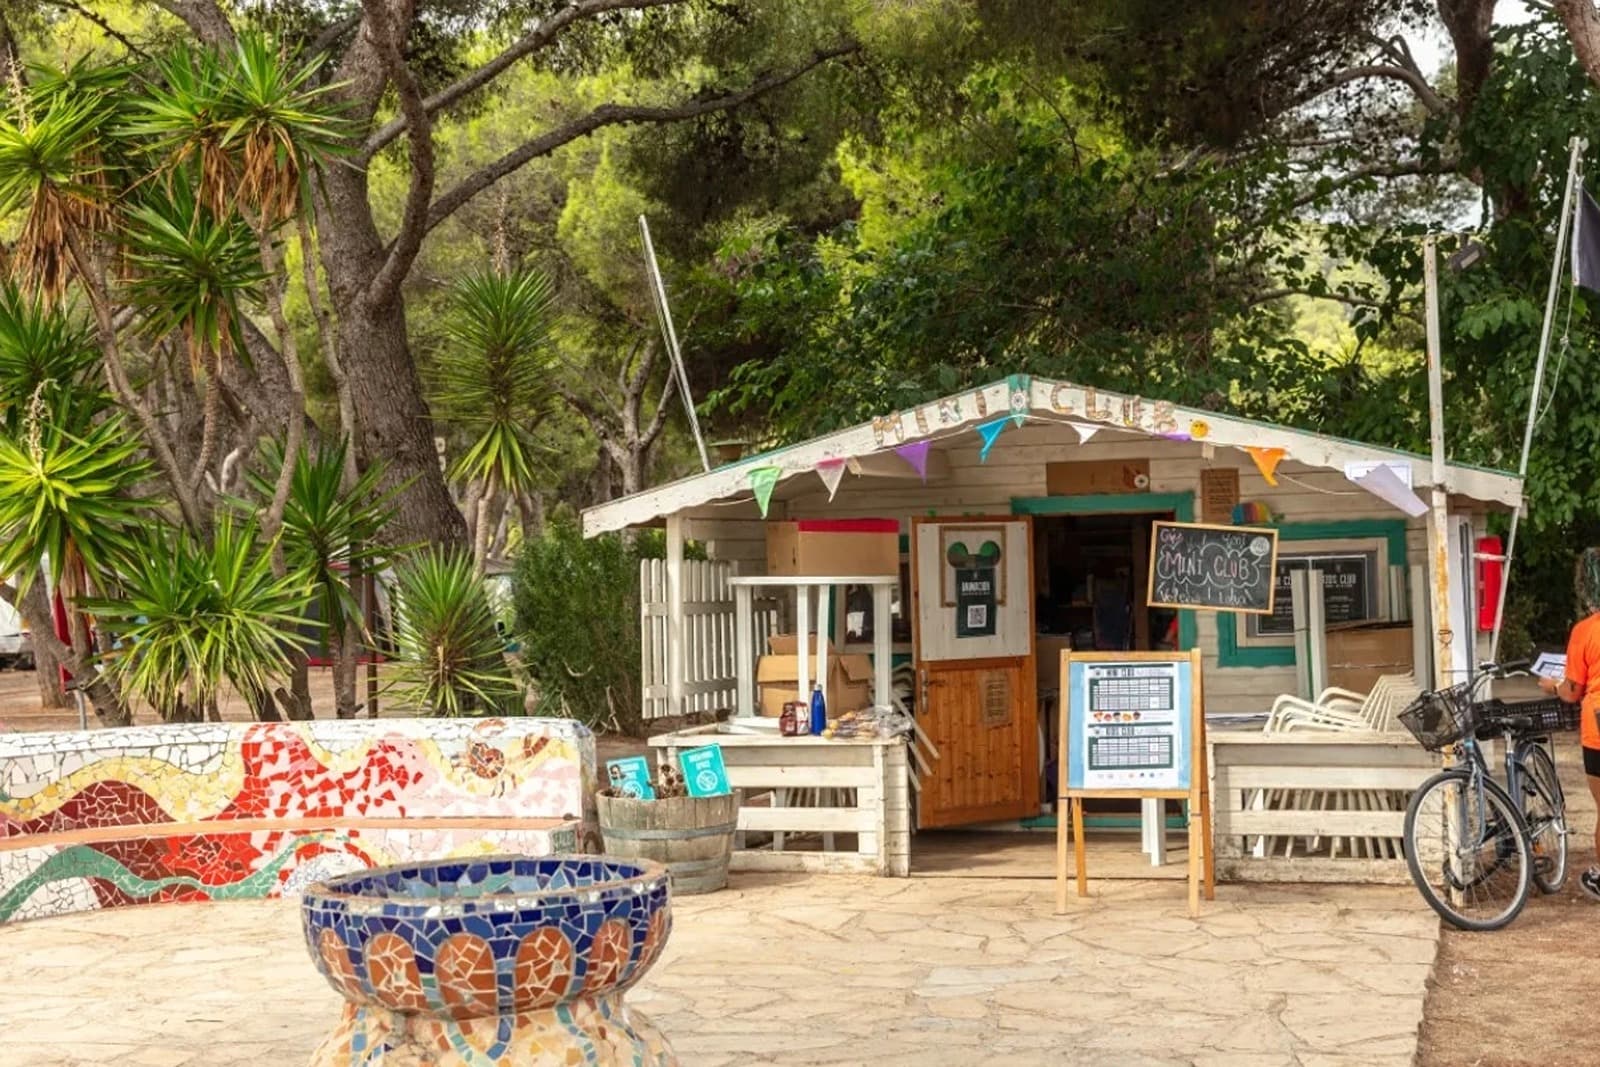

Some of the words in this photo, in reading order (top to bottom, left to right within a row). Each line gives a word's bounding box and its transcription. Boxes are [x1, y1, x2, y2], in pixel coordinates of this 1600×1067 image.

[872, 390, 987, 446] MINI
[1050, 381, 1178, 434] CLUB
[1213, 555, 1249, 580] CLUB
